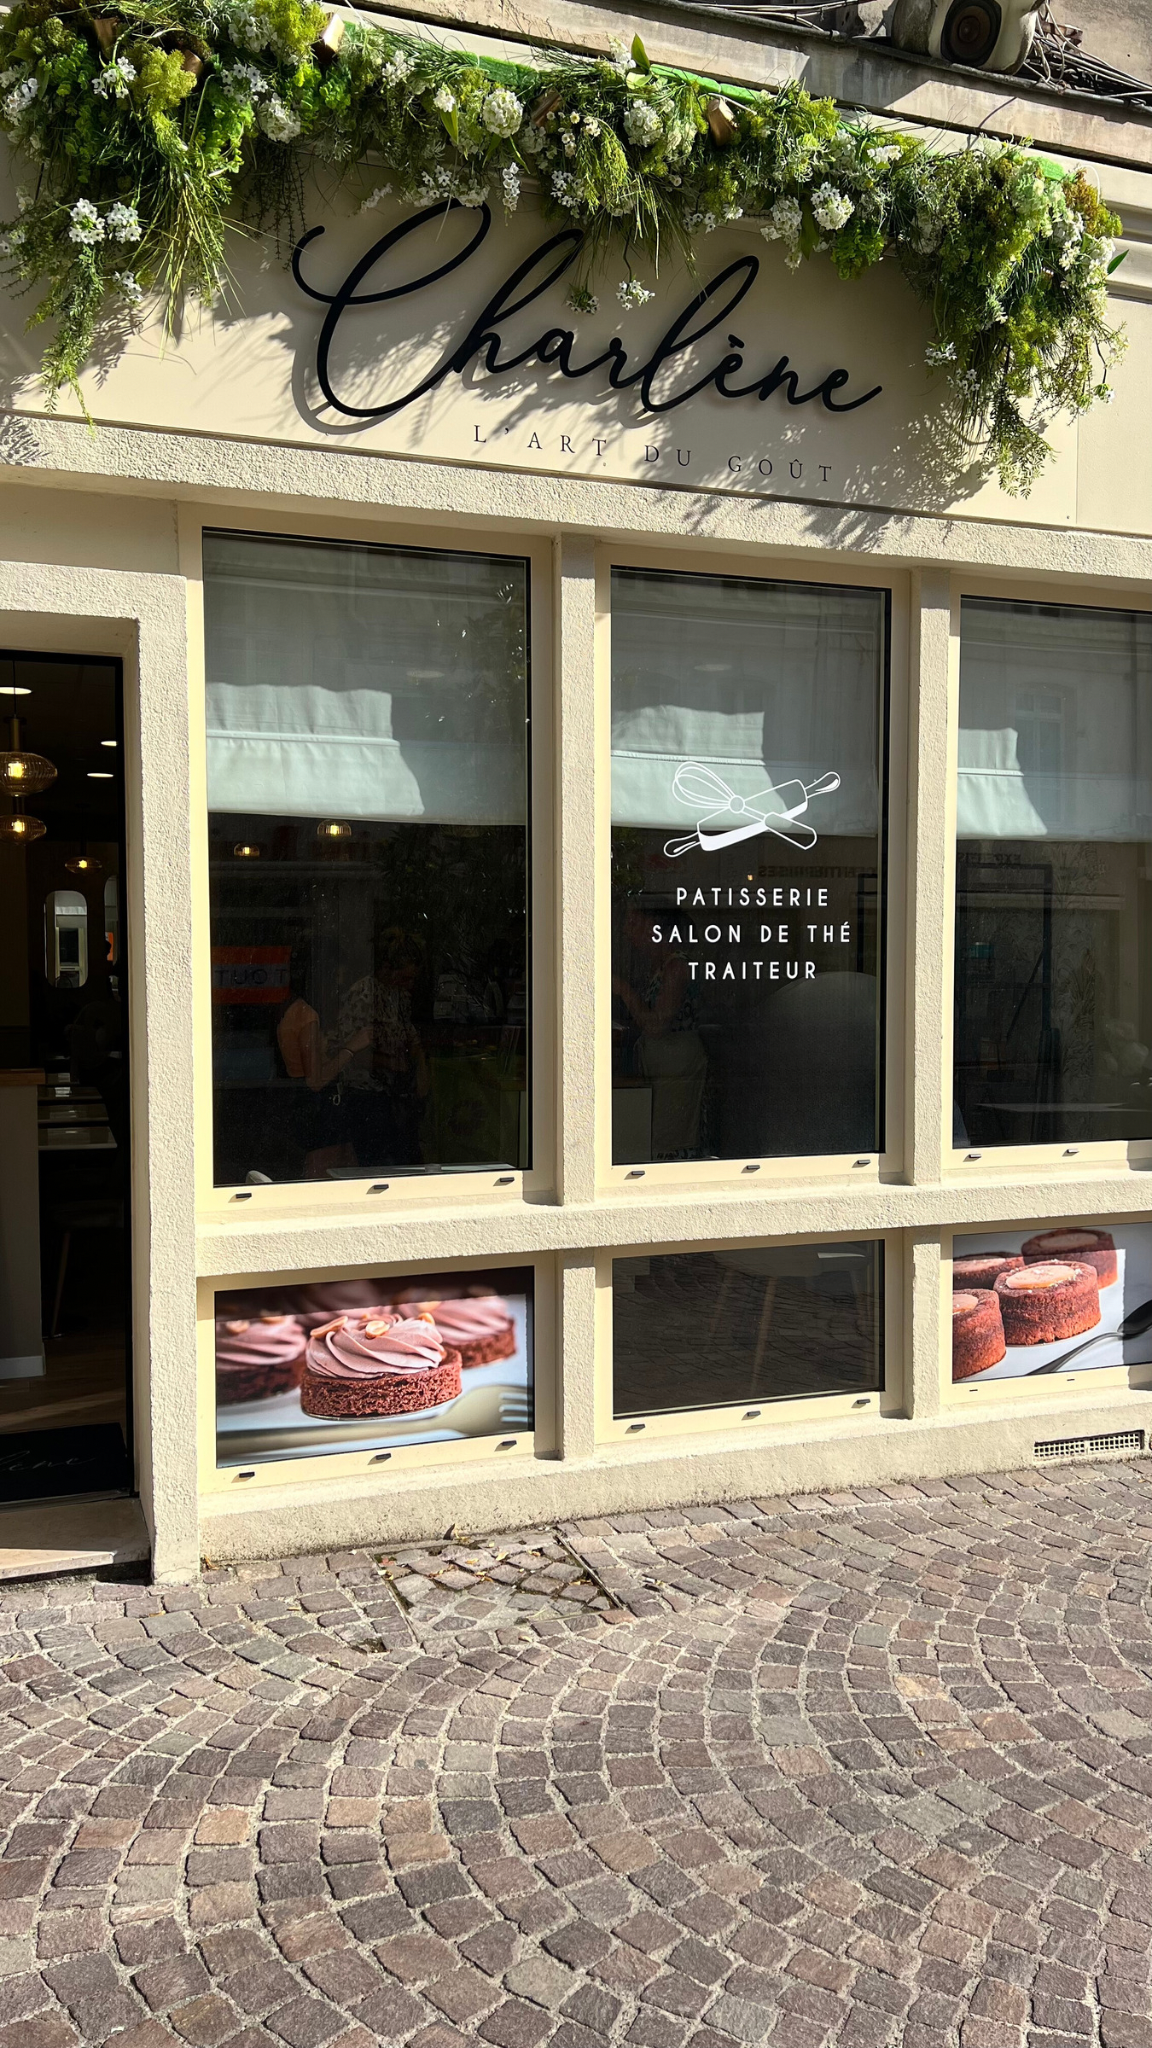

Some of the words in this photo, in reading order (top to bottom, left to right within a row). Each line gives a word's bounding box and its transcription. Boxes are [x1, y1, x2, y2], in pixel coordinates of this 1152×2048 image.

[292, 198, 883, 418] Charlène
[644, 445, 691, 467] DU
[728, 456, 832, 482] GOÛT
[676, 887, 828, 907] PATISSERIE
[651, 924, 741, 943] SALON
[760, 924, 789, 943] DE
[806, 921, 850, 943] THÉ
[688, 961, 816, 980] TRAITEUR
